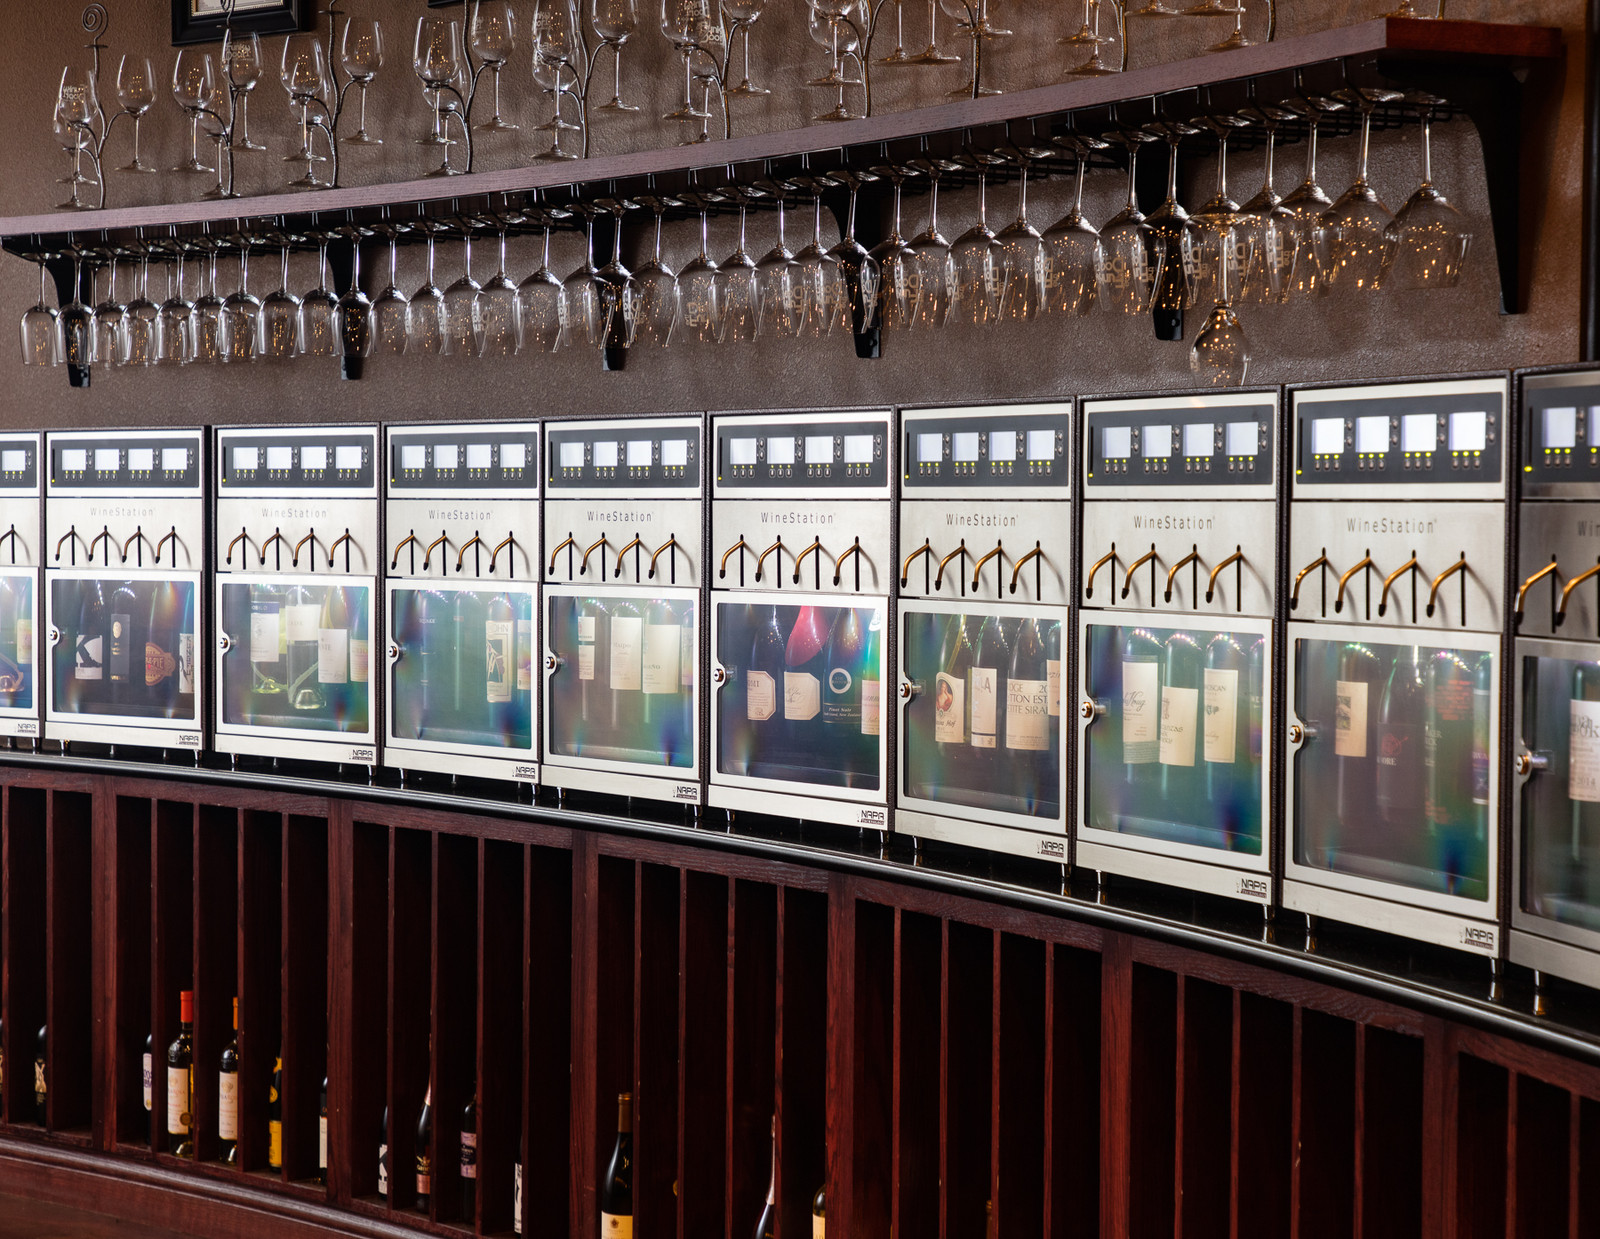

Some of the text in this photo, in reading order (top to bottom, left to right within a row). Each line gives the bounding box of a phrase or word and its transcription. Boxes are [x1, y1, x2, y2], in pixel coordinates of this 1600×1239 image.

[90, 507, 154, 517] WineStation
[262, 508, 327, 518] WineStation
[429, 509, 491, 520] WineStation
[587, 511, 652, 522] WineStation
[761, 512, 833, 524] WineStation
[946, 513, 1016, 527] WineStation
[1134, 515, 1213, 530] WineStation
[1347, 518, 1434, 534] WineStation
[352, 749, 373, 757] NAPA
[516, 766, 535, 775] NAPA
[676, 786, 697, 795] NAPA
[861, 810, 884, 820] NAPA
[1041, 840, 1064, 852] NAPA
[1241, 878, 1267, 892] NAPA
[1465, 927, 1494, 944] NAPA
